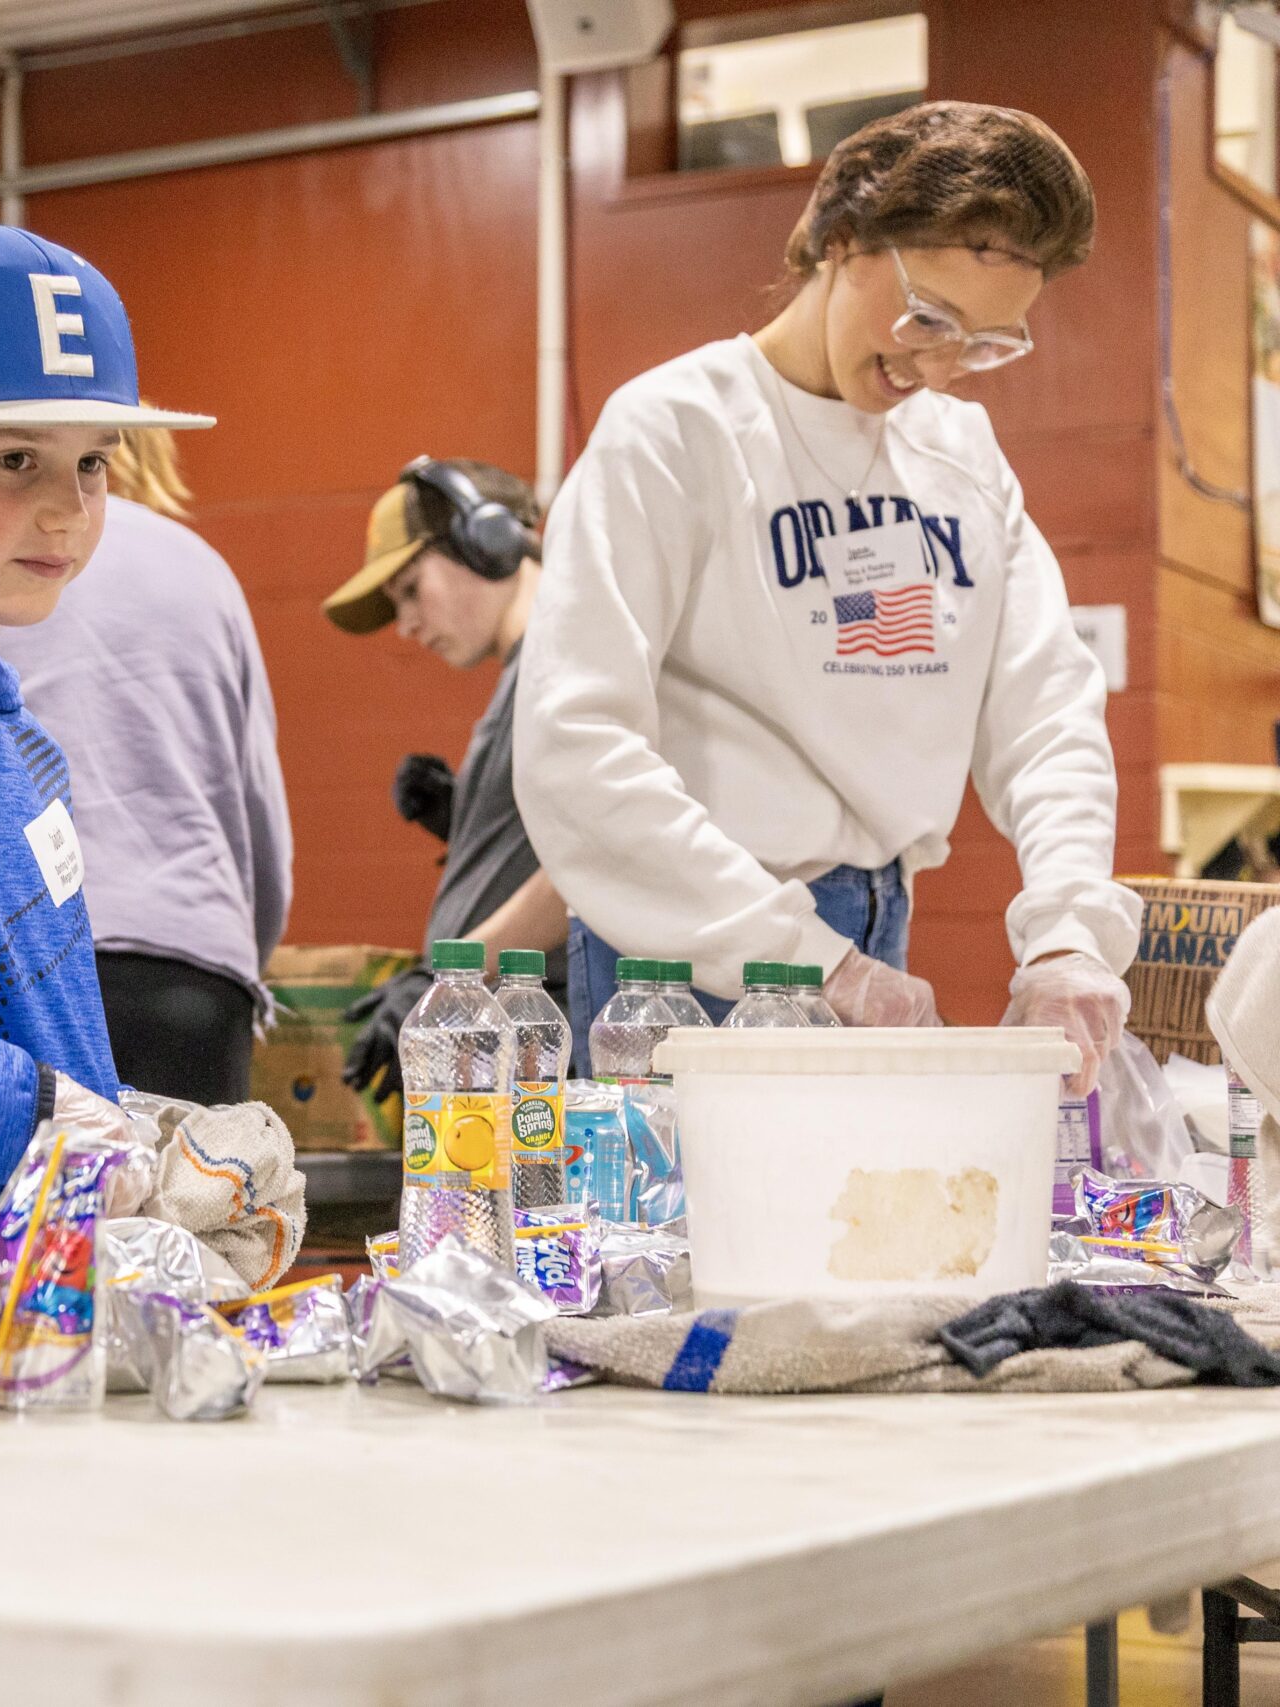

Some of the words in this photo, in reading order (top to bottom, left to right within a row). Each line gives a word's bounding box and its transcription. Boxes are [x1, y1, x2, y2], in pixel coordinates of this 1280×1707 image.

[28, 273, 94, 378] E
[810, 610, 827, 624] 20
[908, 661, 949, 674] YEARS
[517, 1107, 552, 1127] Poland
[519, 1119, 553, 1138] Spring
[525, 1131, 551, 1144] ORANGE
